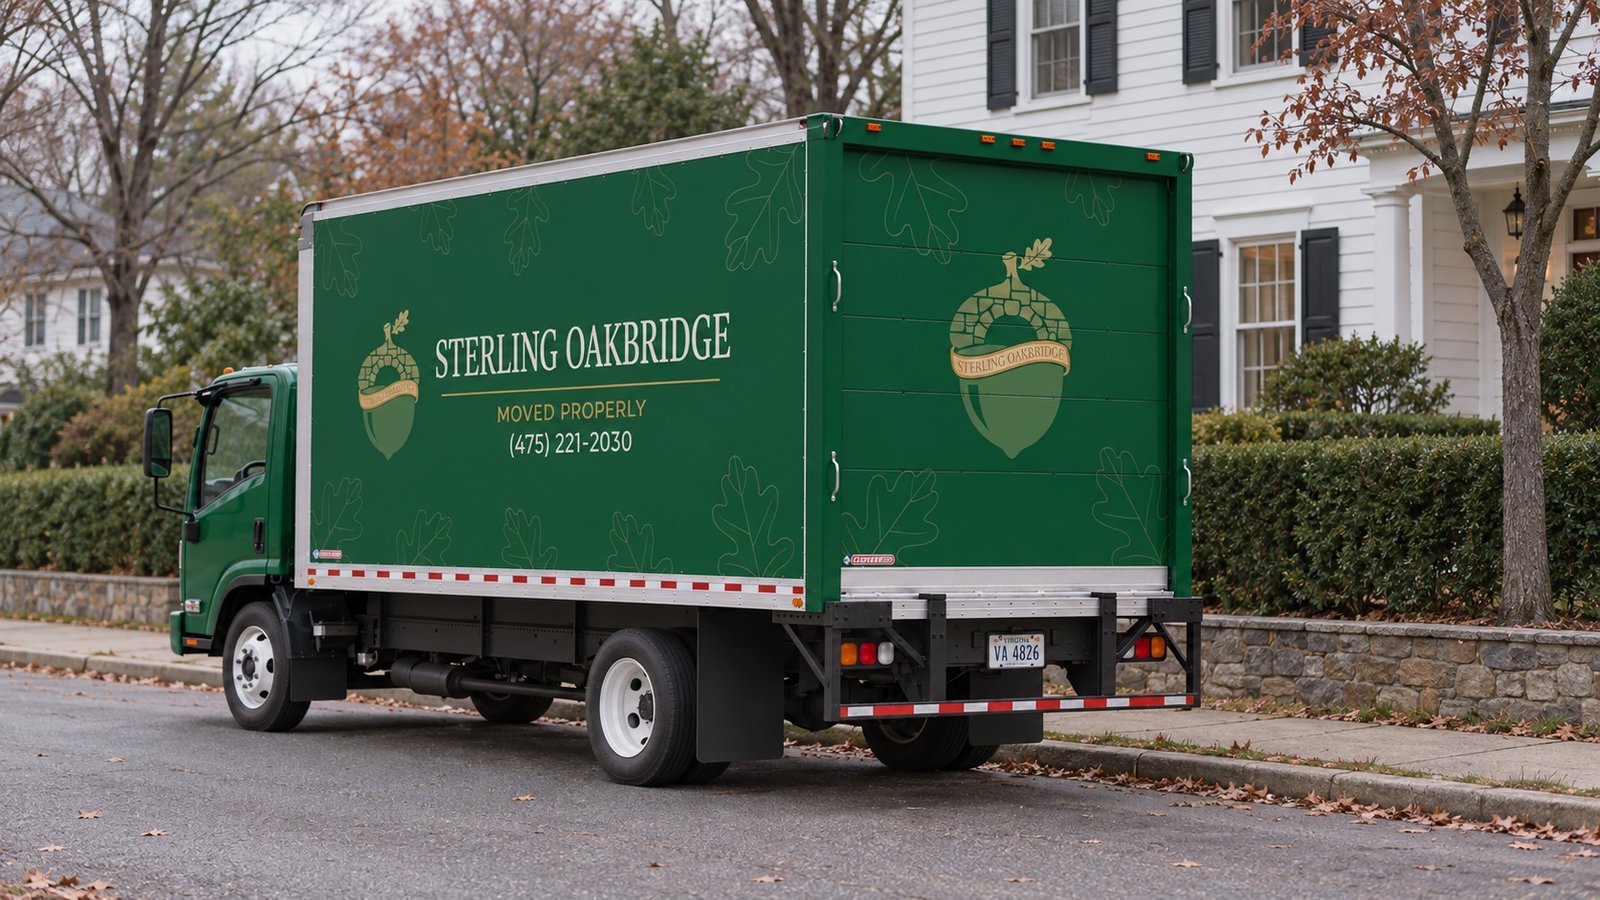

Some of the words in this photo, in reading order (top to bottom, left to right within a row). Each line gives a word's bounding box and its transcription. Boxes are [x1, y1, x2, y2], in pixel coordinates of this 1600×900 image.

[435, 328, 558, 379] STERLING
[566, 312, 731, 369] OAKBRIDGE
[957, 355, 1005, 374] STERLING
[496, 403, 555, 423] MOVED
[560, 399, 647, 420] PROPERLY
[508, 431, 550, 458] (475)
[555, 431, 633, 454] 221-2030
[994, 645, 1008, 661] VA
[1012, 644, 1039, 661] 4826
